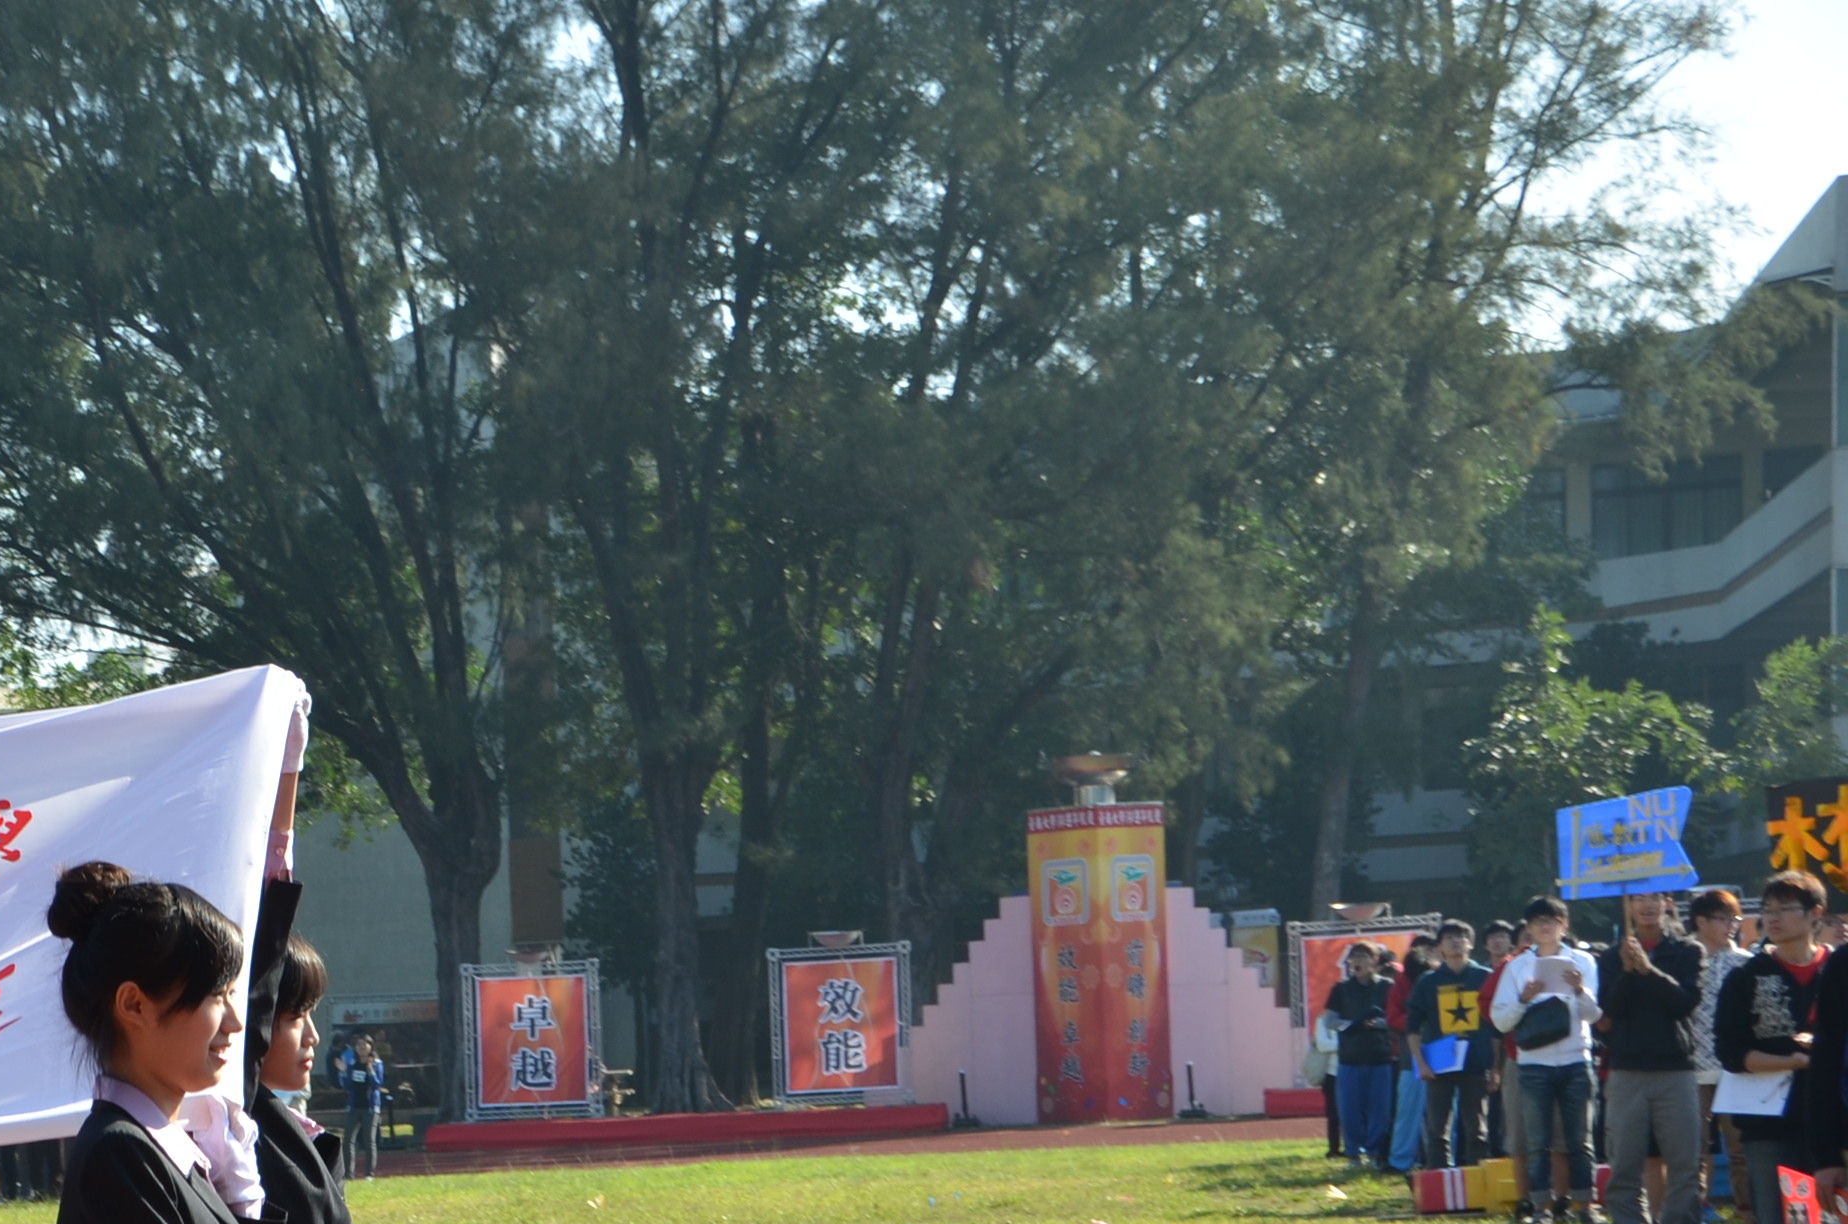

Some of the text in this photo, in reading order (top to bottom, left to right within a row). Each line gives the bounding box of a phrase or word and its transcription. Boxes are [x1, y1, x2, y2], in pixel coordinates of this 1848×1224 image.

[1628, 792, 1677, 820] NU
[1631, 817, 1679, 844] TN
[510, 994, 558, 1091] 卓越
[817, 978, 868, 1075] 效能
